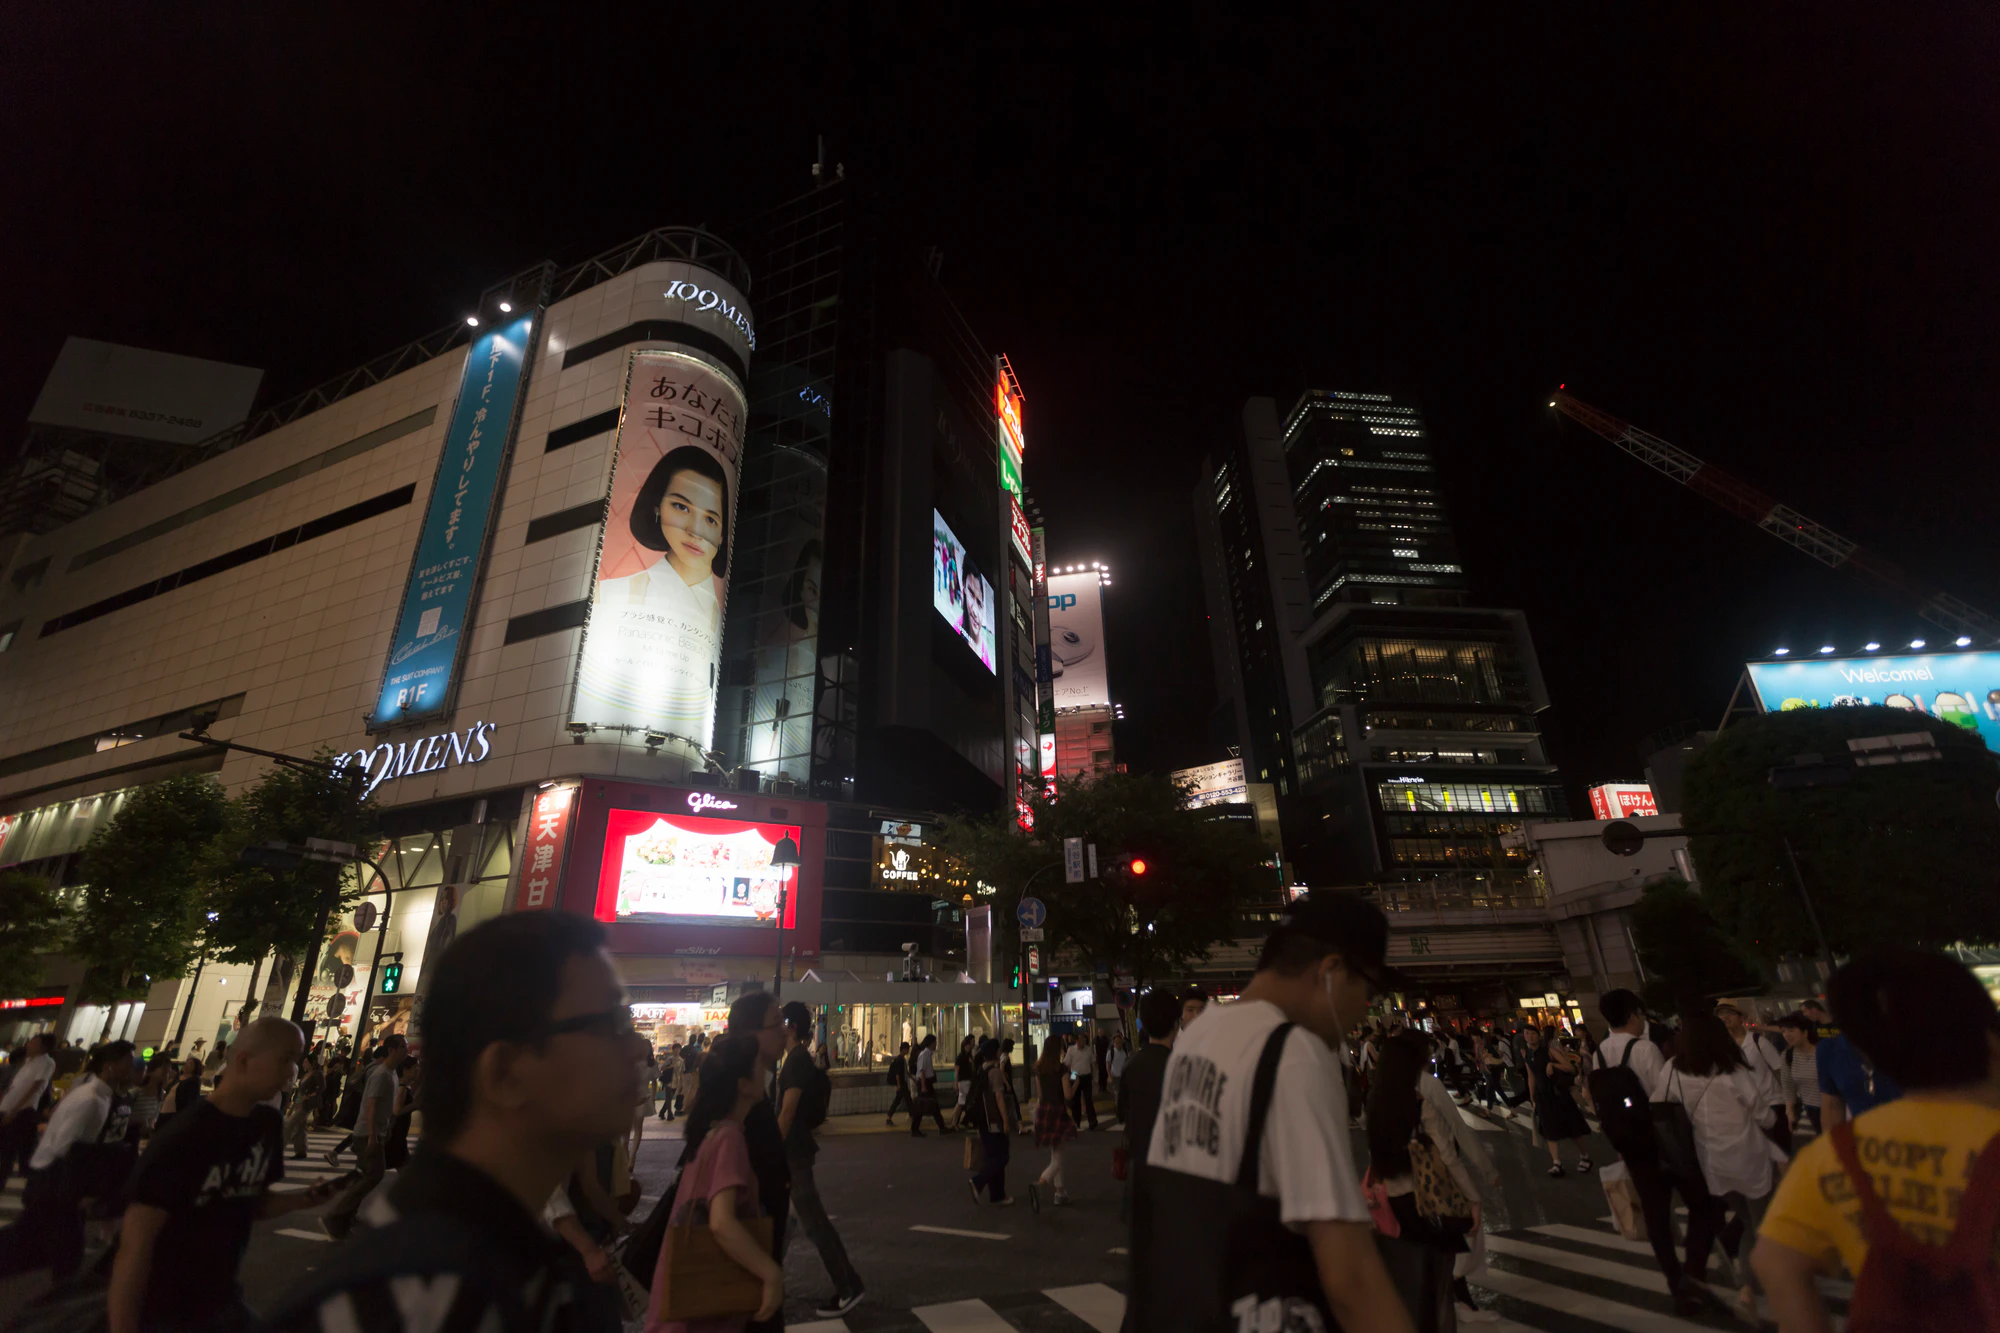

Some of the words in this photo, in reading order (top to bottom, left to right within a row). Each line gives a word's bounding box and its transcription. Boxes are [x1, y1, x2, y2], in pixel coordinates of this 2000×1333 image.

[651, 376, 740, 442] あなたも
[391, 676, 402, 685] THE
[402, 672, 414, 682] SUIT
[414, 665, 445, 679] COMPANY
[396, 683, 428, 707] B1F
[688, 792, 738, 812] Glico
[882, 869, 918, 881] COFFEE
[1410, 936, 1431, 955] 駅
[704, 1010, 729, 1021] TAX
